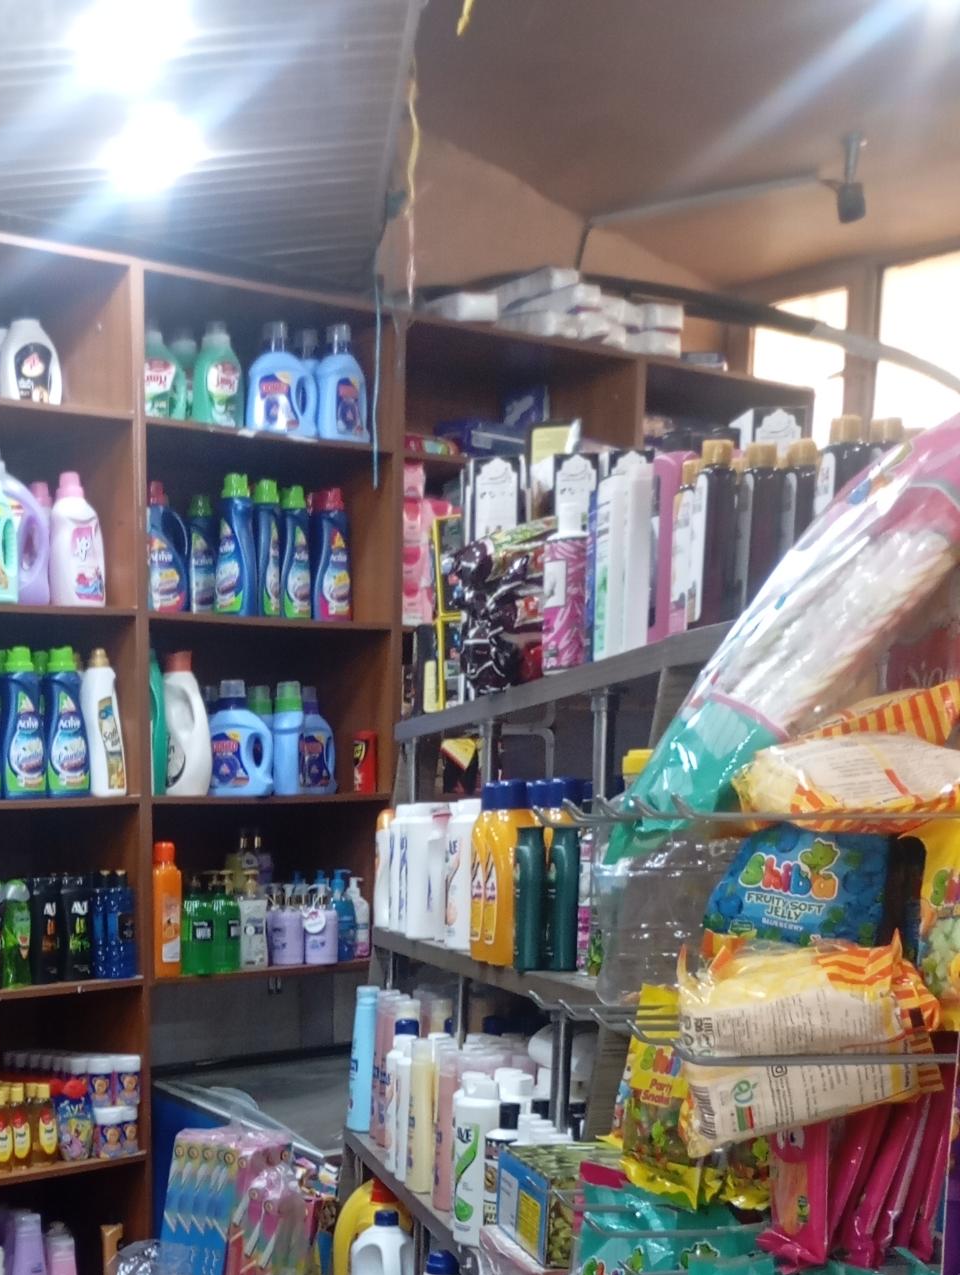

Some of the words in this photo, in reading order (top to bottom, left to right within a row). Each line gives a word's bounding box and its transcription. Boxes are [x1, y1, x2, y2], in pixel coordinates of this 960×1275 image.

[739, 853, 839, 900] Shiba
[746, 892, 790, 910] FRUITY
[790, 900, 825, 914] SOFT
[766, 904, 803, 921] JELLY
